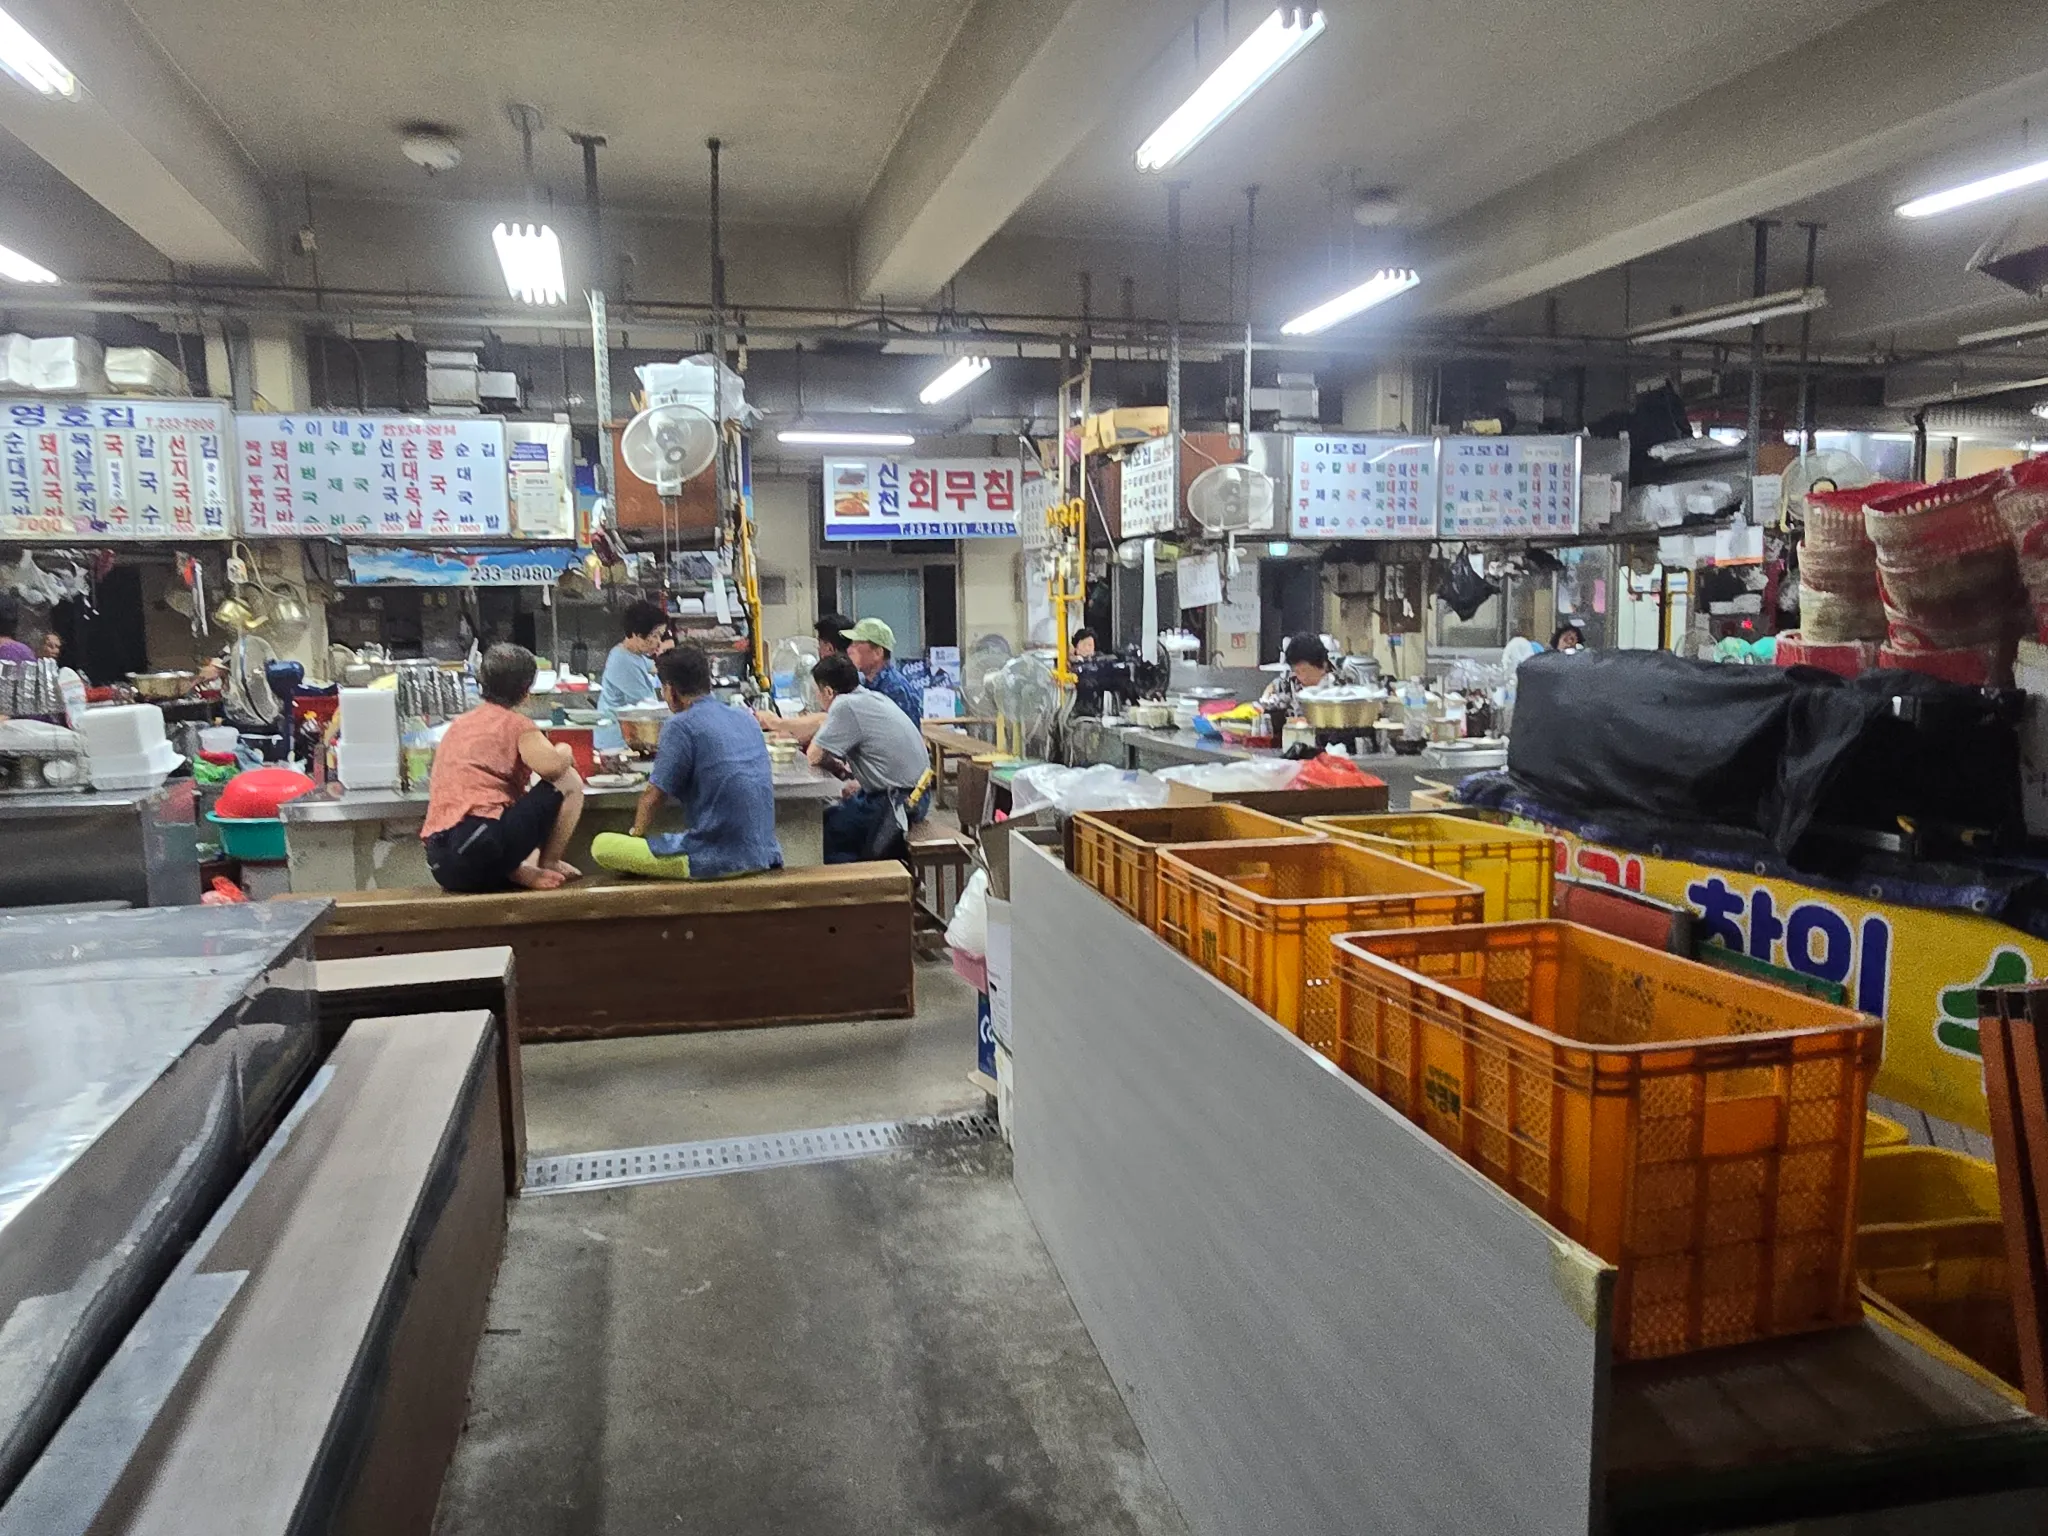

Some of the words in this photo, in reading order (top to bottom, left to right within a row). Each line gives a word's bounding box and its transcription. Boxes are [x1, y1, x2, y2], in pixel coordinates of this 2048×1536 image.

[1314, 443, 1367, 456] 이모집
[1458, 444, 1509, 457] 고모집
[877, 462, 899, 517] 신천
[908, 468, 1015, 512] 회무침
[1687, 878, 1891, 1019] 차이
